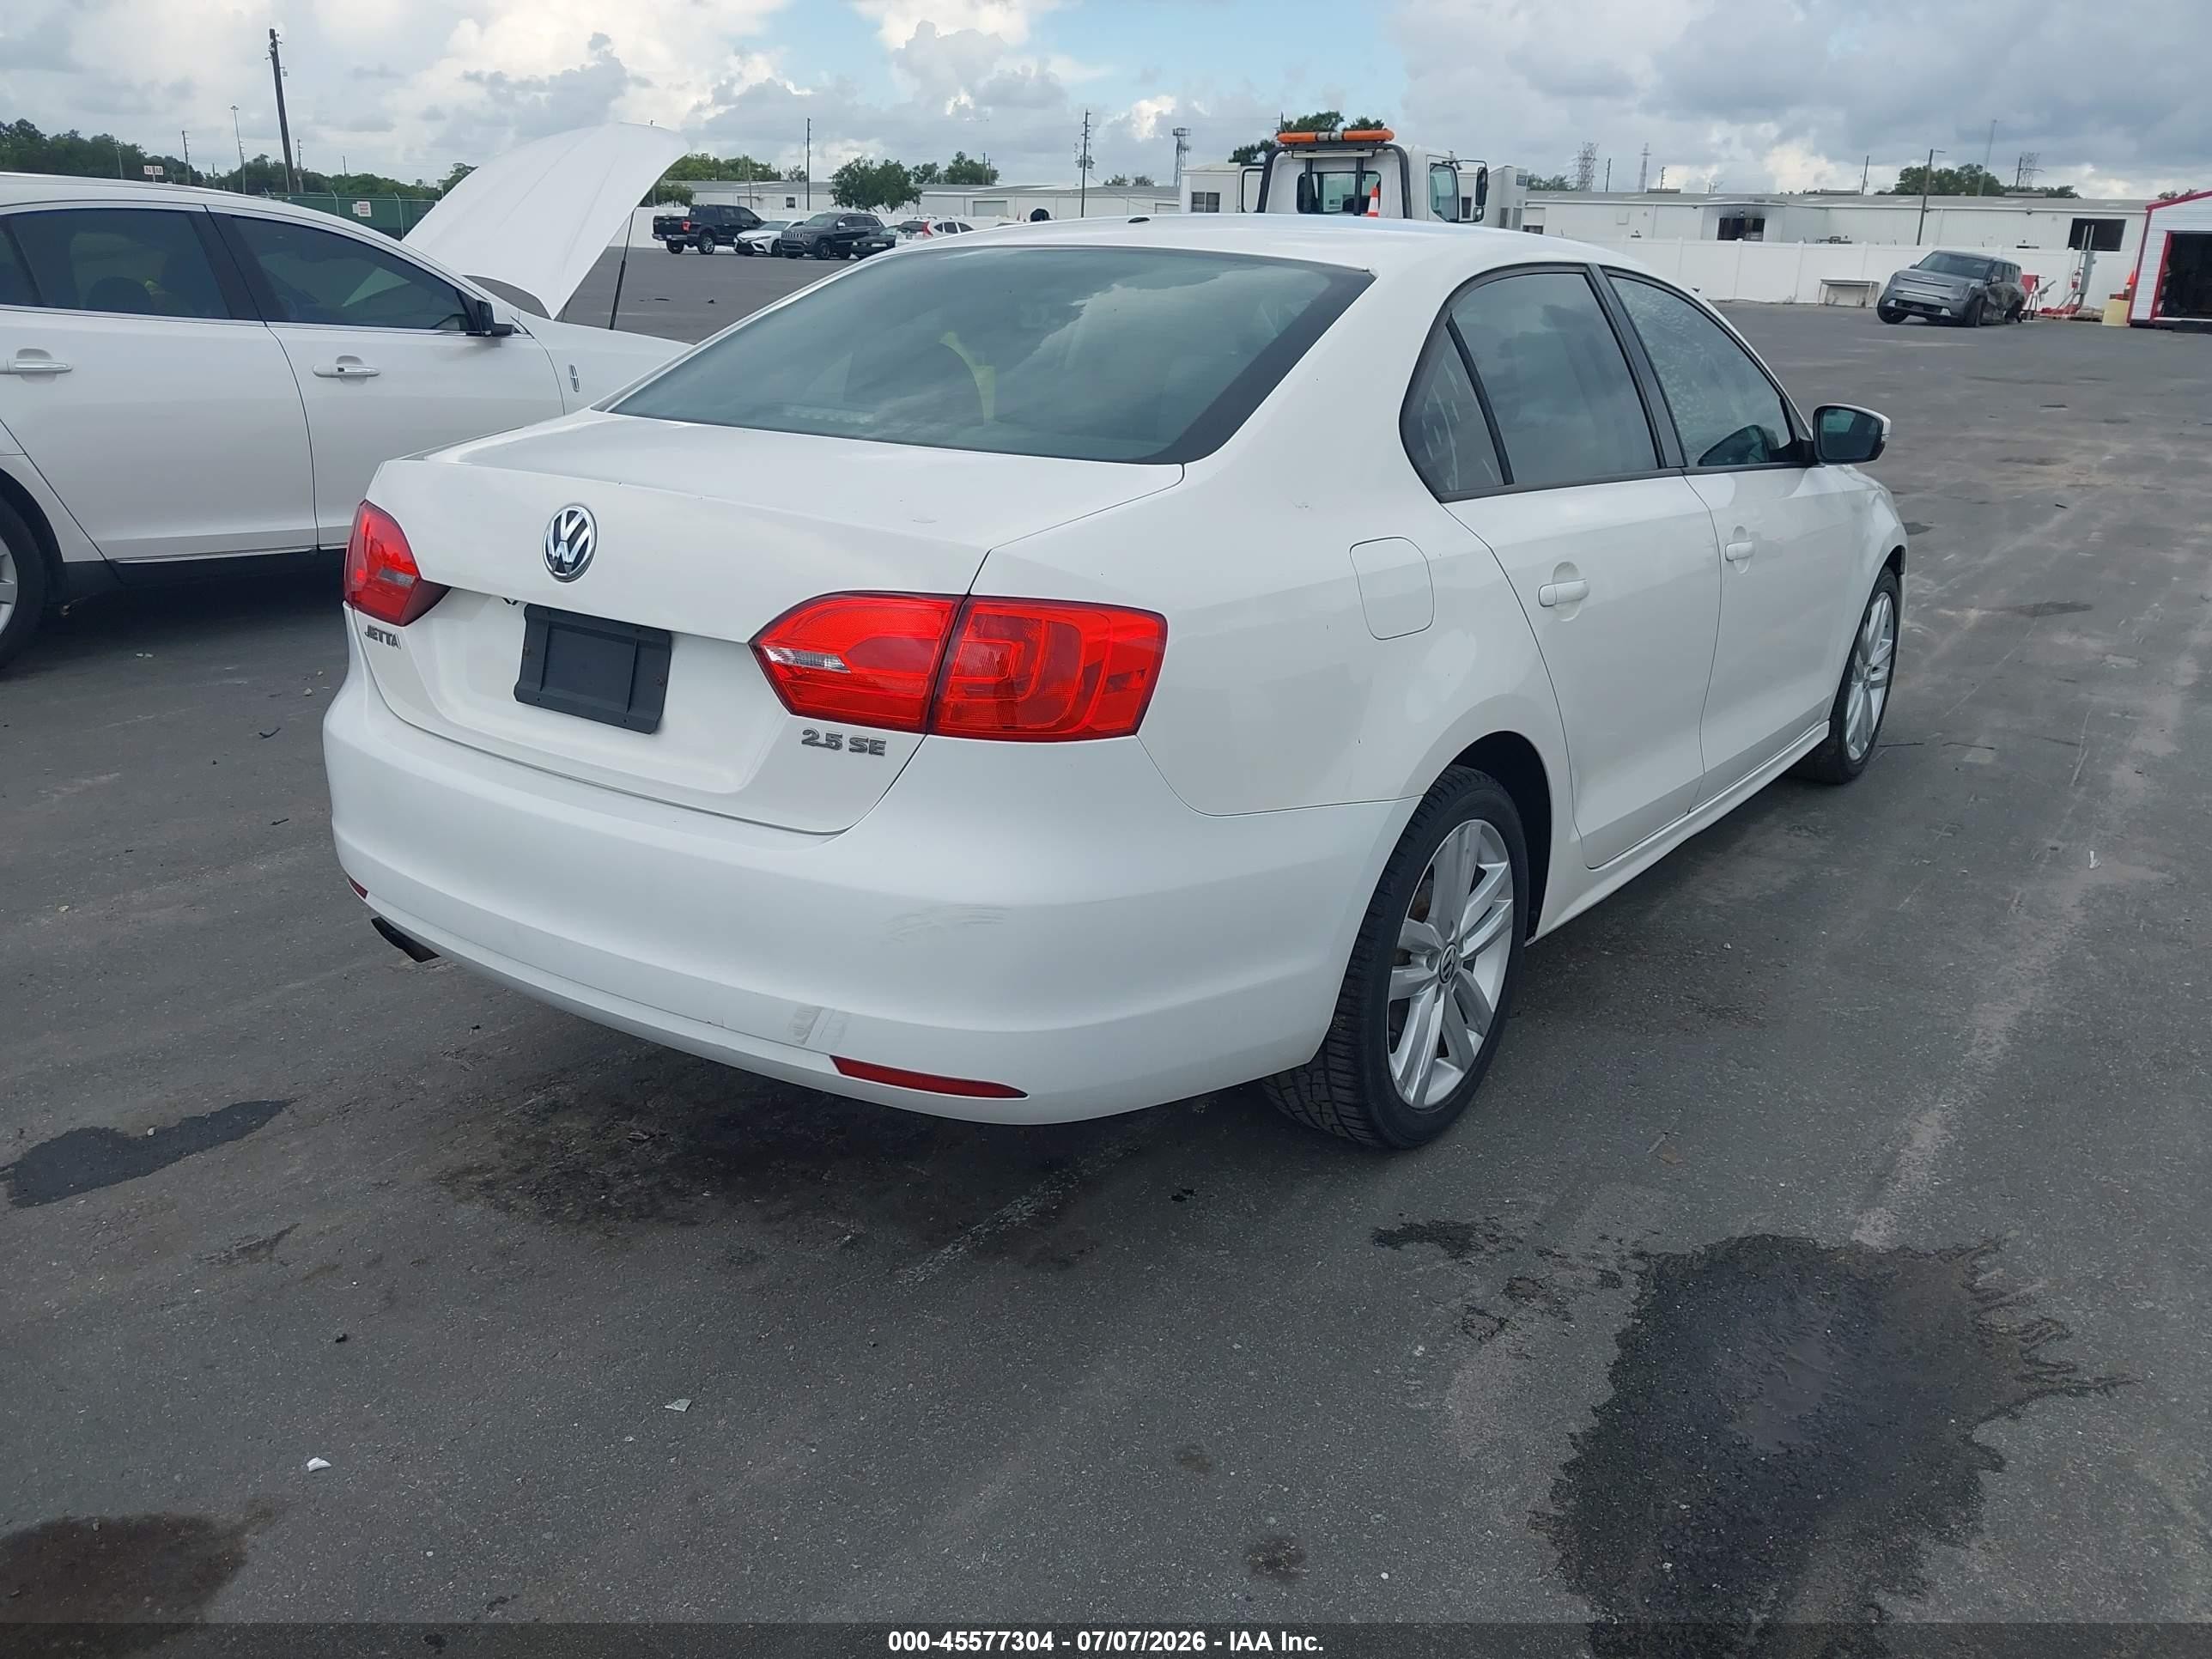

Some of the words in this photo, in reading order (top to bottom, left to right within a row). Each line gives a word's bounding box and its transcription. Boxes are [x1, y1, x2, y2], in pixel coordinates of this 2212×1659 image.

[544, 505, 596, 581] VW
[364, 625, 401, 649] JETTA
[801, 727, 843, 750] 2.5
[848, 735, 886, 757] SE
